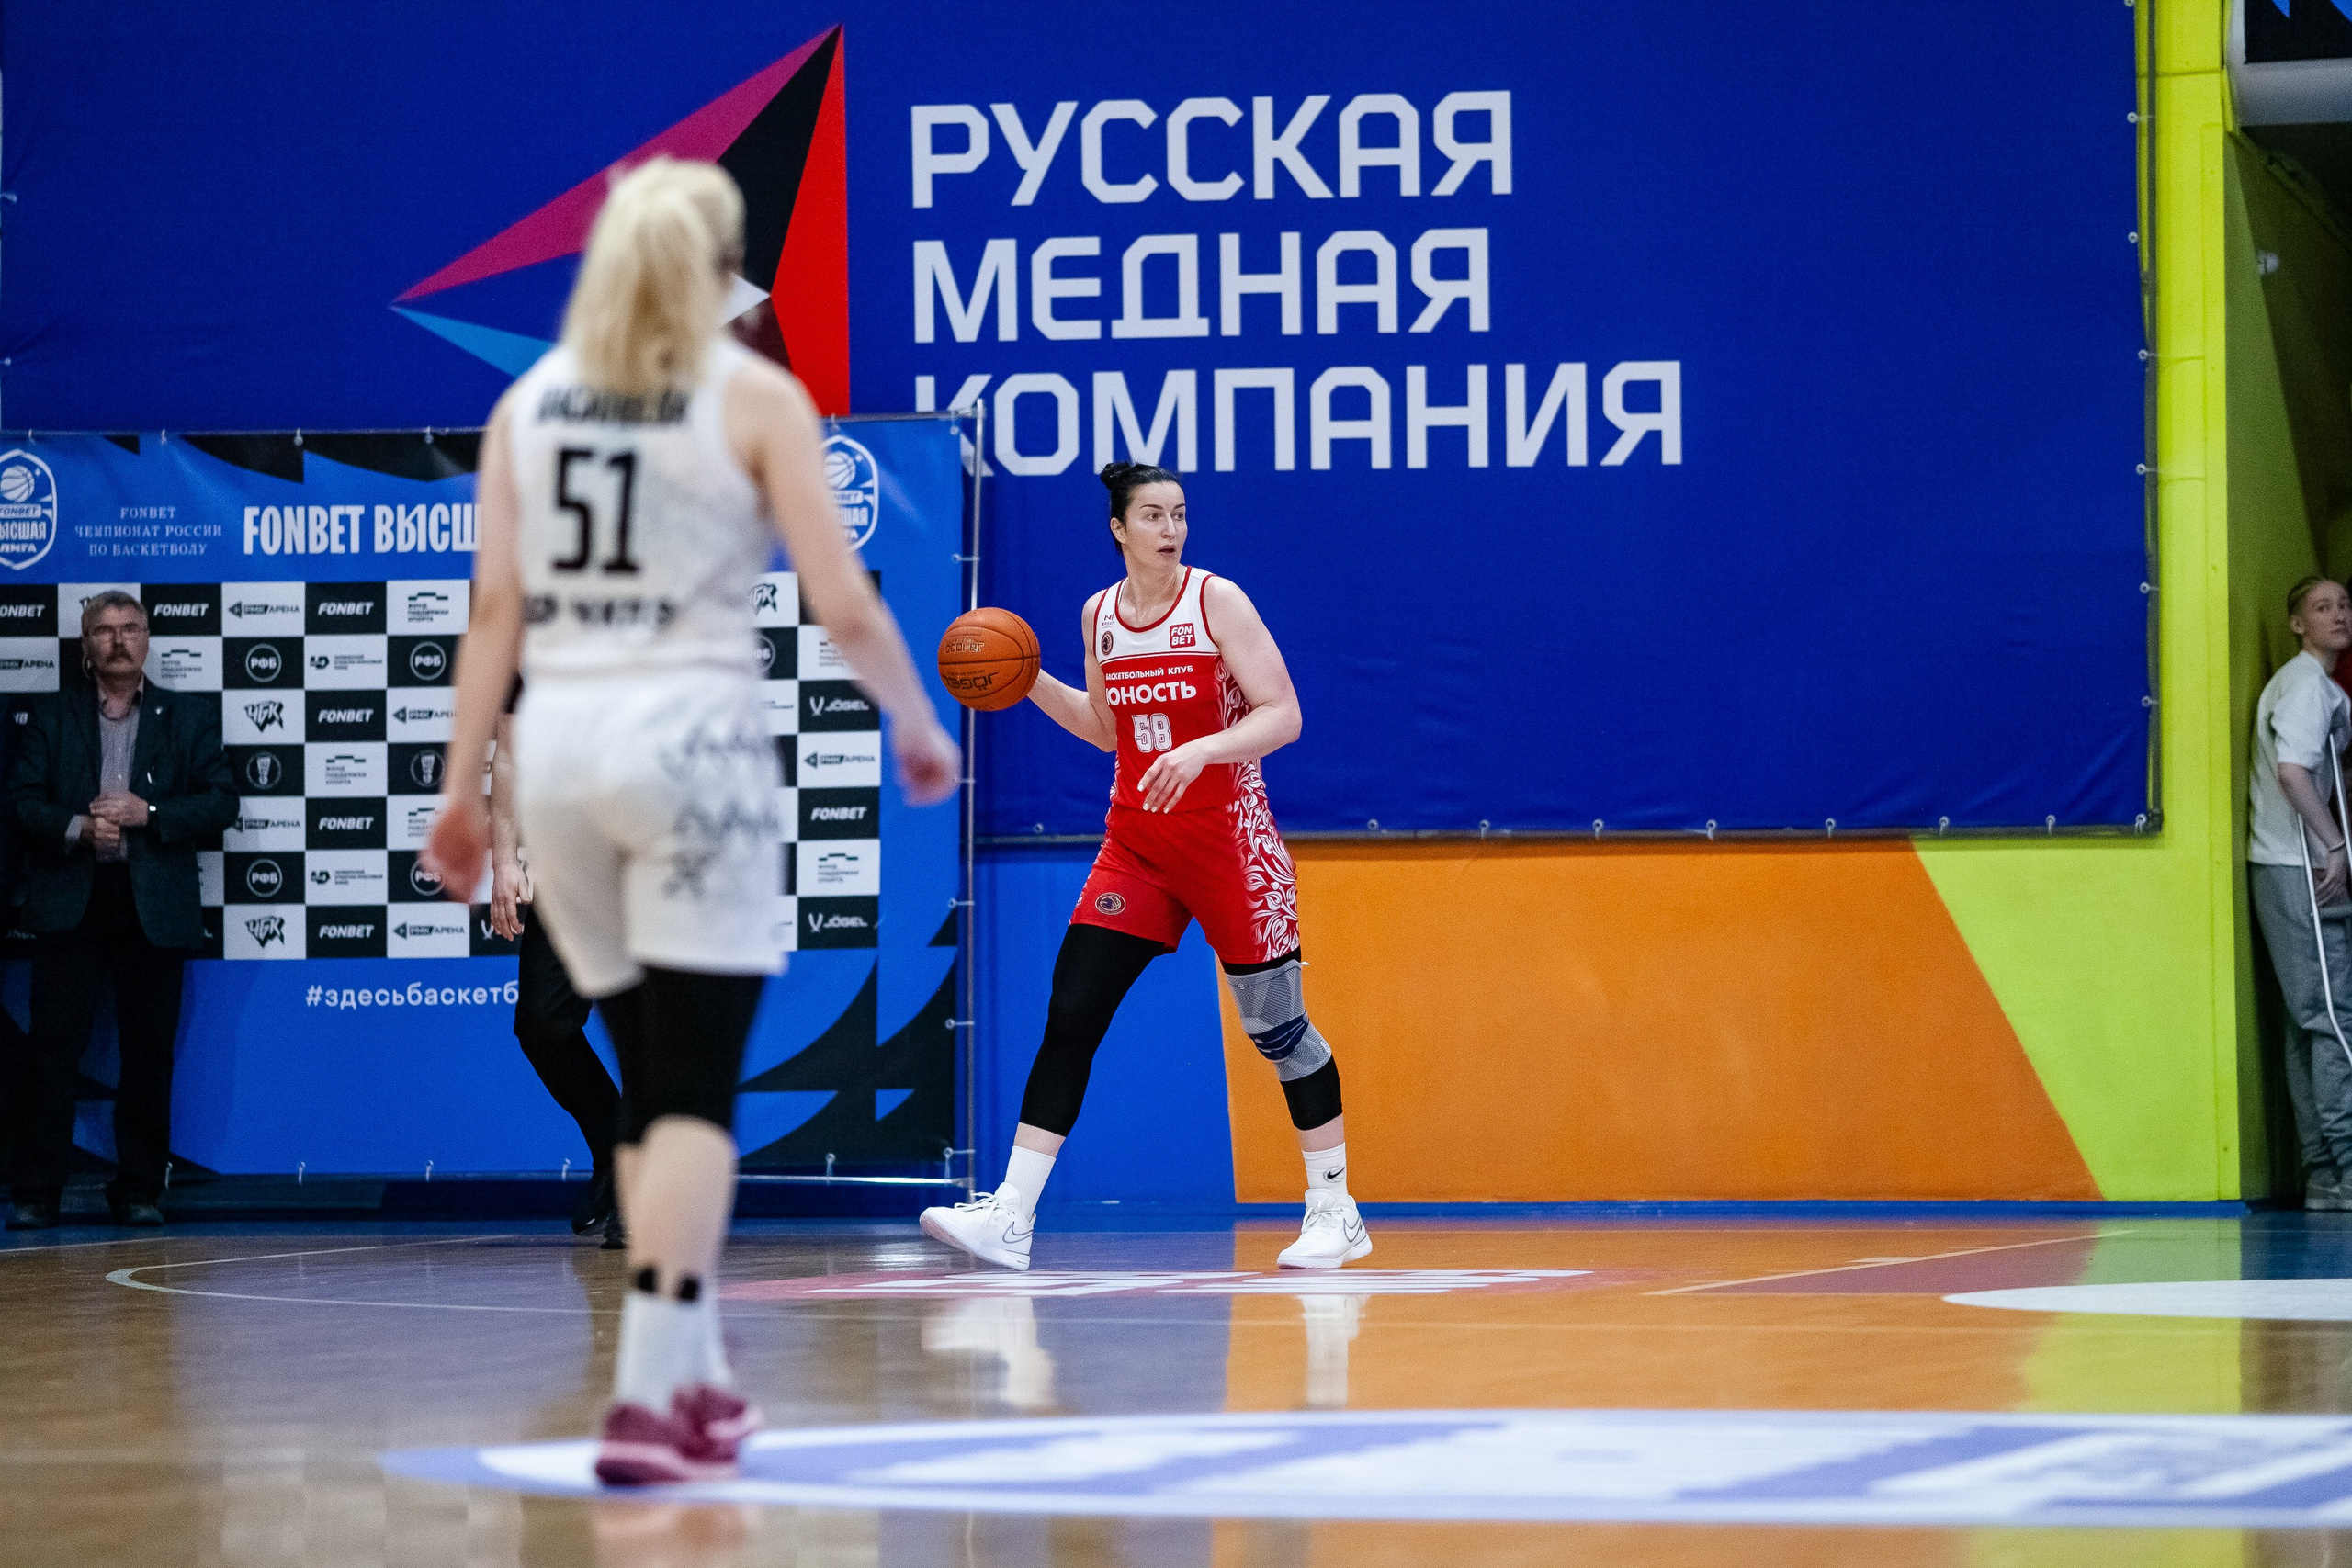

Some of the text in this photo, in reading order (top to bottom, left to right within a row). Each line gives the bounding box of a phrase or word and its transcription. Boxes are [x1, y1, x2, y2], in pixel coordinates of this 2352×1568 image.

[911, 91, 1512, 209] РУССКАЯ
[913, 228, 1490, 344] МЕДНАЯ
[915, 360, 1682, 477] КОМПАНИЯ
[120, 507, 176, 519] FONBET
[550, 446, 642, 573] 51
[74, 524, 222, 538] ЧЕМПИОНАТ РОССИИ
[243, 505, 365, 555] FONBET
[89, 542, 208, 557] ПО БАСКЕТБОЛУ
[0, 604, 45, 617] ONBET
[153, 603, 209, 617] FONBET
[318, 601, 375, 615] FONBET
[1170, 626, 1193, 637] FON
[1171, 635, 1193, 646] BET
[1168, 665, 1193, 676] КЛУБ
[318, 709, 374, 723] FONBET
[1131, 713, 1173, 753] 58
[810, 806, 867, 821] FONBET
[318, 816, 375, 830] FONBET
[318, 924, 375, 939] FONBET
[305, 979, 520, 1010] #здесьбаскетб
